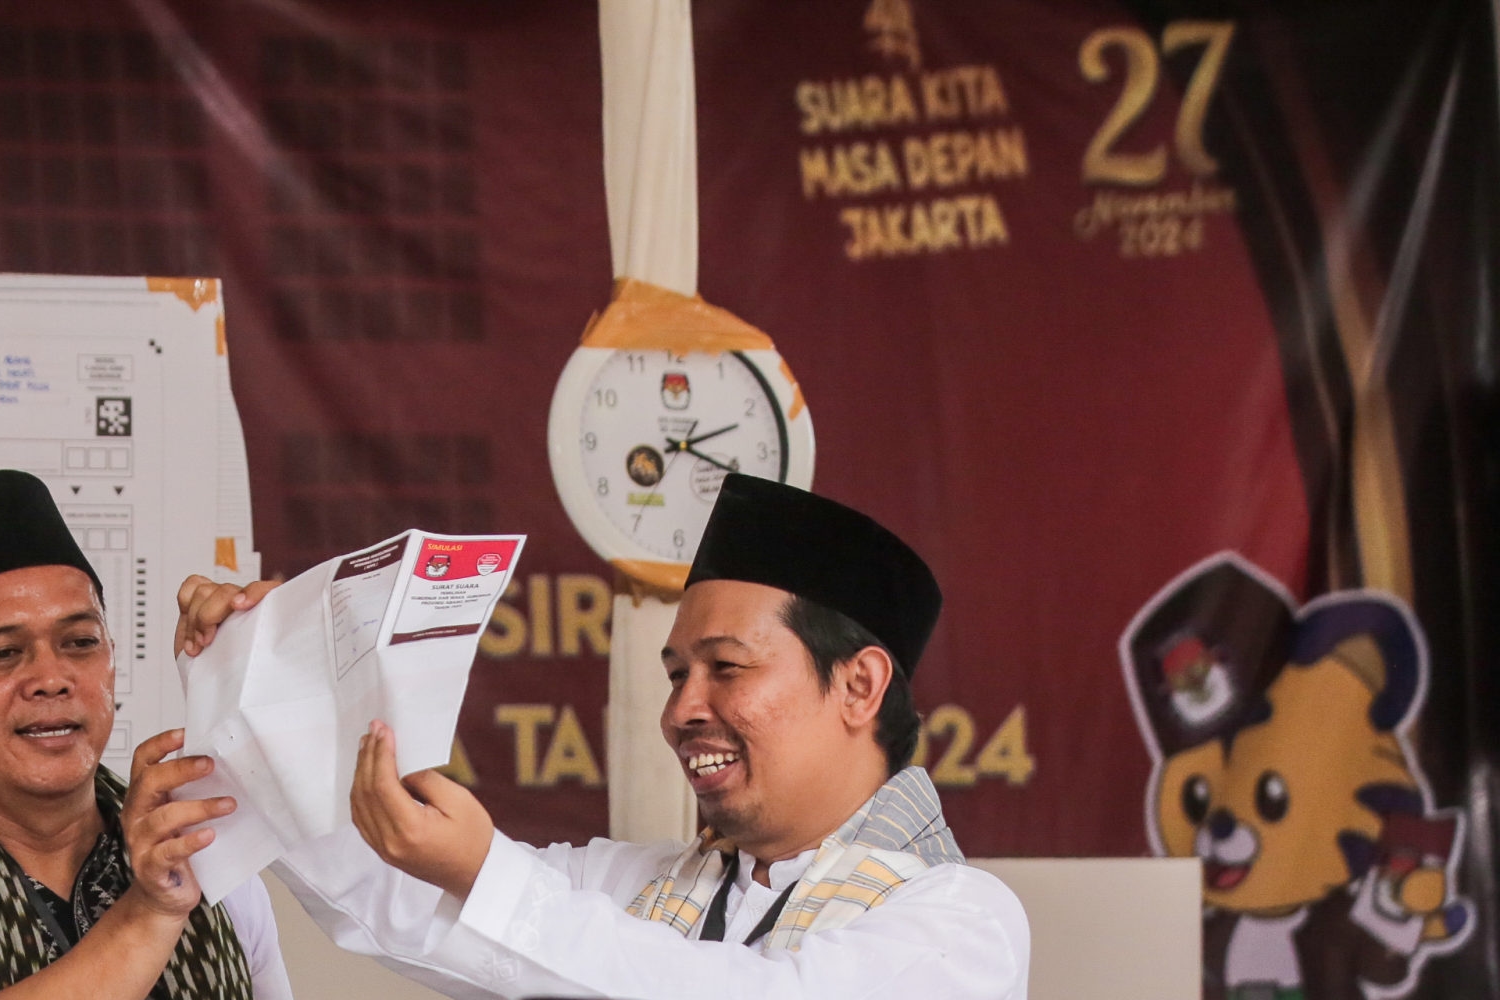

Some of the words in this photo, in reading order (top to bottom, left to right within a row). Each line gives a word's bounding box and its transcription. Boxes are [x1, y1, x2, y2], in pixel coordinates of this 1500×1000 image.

[796, 74, 916, 134] SUARA
[922, 65, 1009, 118] KITA
[1078, 19, 1237, 186] 27
[800, 141, 899, 198] MASA
[903, 129, 1028, 188] DEPAN
[840, 194, 1009, 262] JAKARTA
[1121, 219, 1205, 257] 2024
[627, 354, 646, 373] 11
[716, 362, 726, 380] 1
[594, 389, 618, 408] 10
[744, 398, 756, 417] 2
[585, 432, 597, 450] 9
[757, 442, 769, 460] 3
[597, 477, 609, 496] 8
[631, 514, 642, 533] 7
[427, 543, 463, 551] SIMULASI
[673, 530, 685, 548] 6
[497, 705, 607, 788] TA
